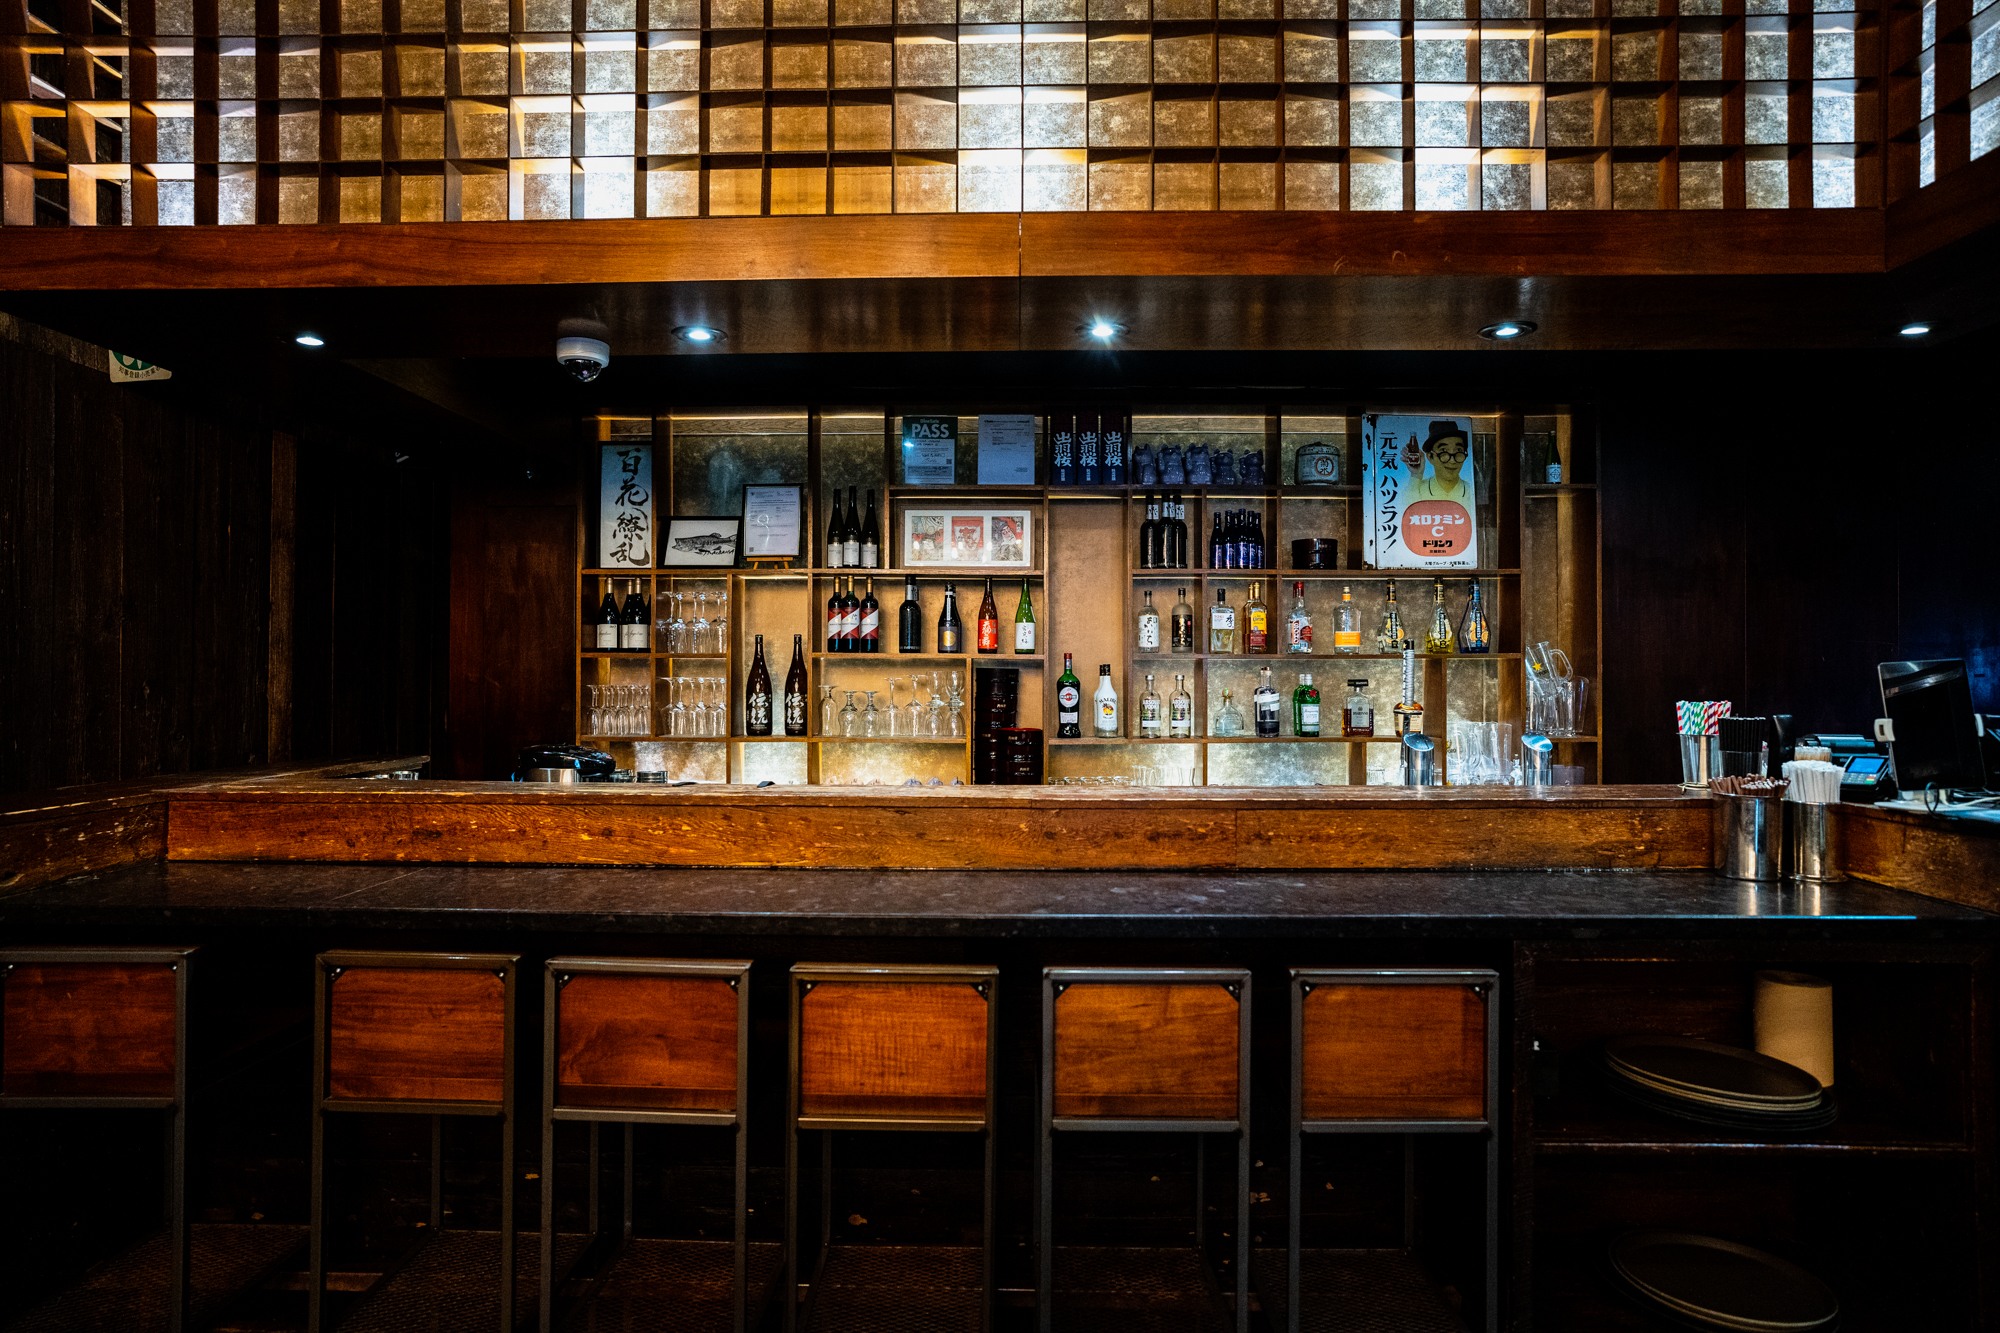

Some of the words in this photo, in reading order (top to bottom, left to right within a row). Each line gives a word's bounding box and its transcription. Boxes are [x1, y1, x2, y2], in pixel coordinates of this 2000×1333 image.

[911, 423, 950, 439] PASS
[609, 449, 650, 566] 百花繚乱
[1409, 514, 1465, 525] オロナミン
[1431, 525, 1445, 537] C
[1422, 539, 1453, 548] ドリンク
[747, 692, 769, 724] 伝統
[785, 692, 805, 724] 伝統
